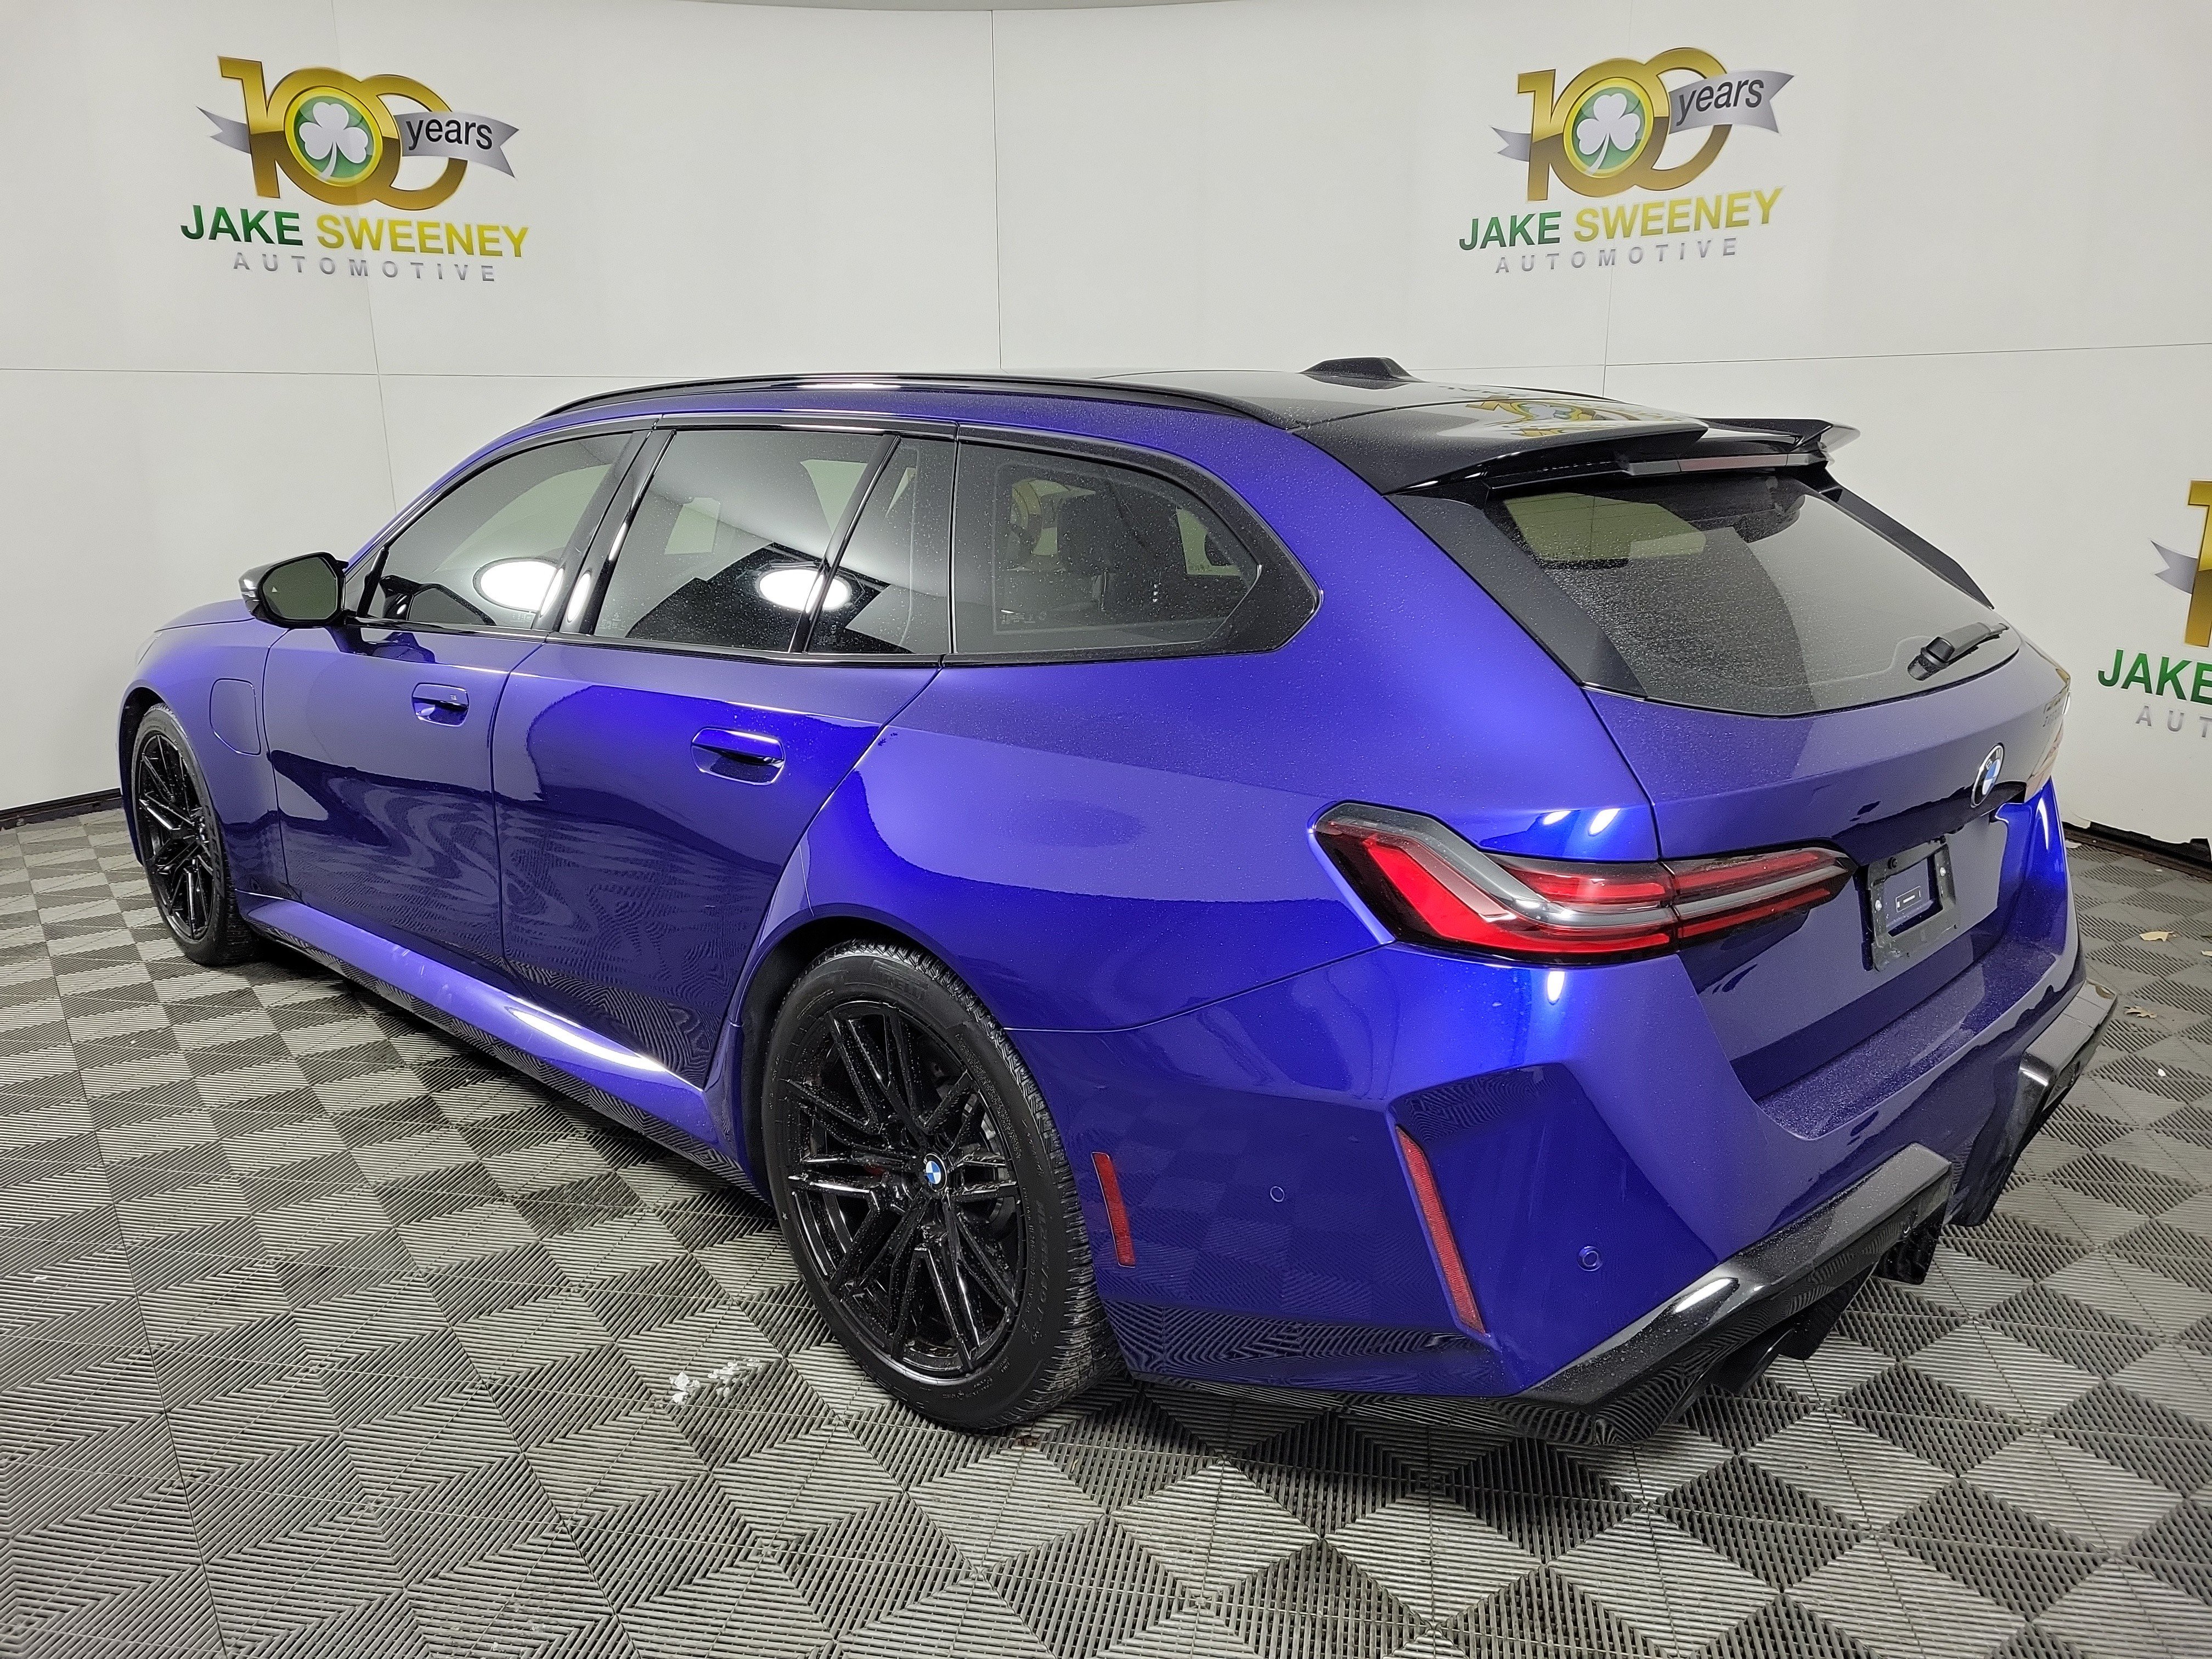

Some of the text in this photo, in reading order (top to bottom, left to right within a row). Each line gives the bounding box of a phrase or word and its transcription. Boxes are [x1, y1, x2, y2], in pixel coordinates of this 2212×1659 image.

[217, 55, 493, 211] 100 years
[1517, 47, 1764, 202] 100 years
[180, 204, 529, 258] JAKE SWEENEY
[1459, 187, 1783, 251] JAKE SWEENEY
[233, 252, 495, 282] AUTOMOTIVE
[1496, 238, 1737, 274] AUTOMOTIVE
[2098, 649, 2212, 706] JAKE
